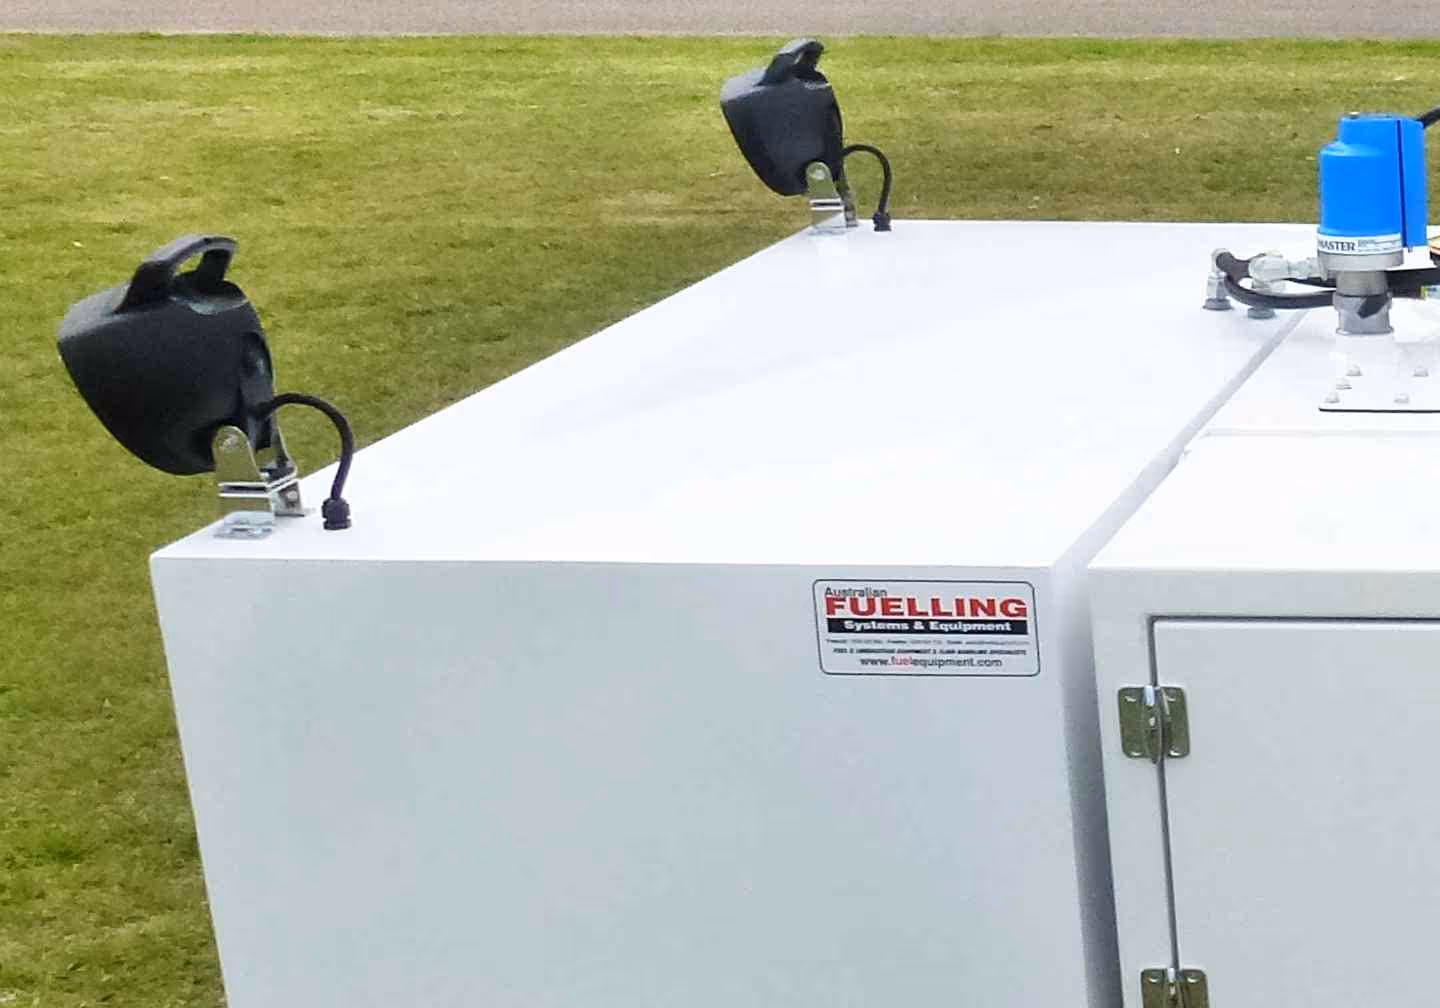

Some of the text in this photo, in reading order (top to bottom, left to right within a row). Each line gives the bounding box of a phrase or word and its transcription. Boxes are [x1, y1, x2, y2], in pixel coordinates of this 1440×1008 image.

[825, 586, 888, 598] Australian
[826, 597, 1028, 618] FUELLING
[844, 620, 1012, 633] Systems & Equipment
[859, 656, 1003, 669] www.fuelequipment.com
